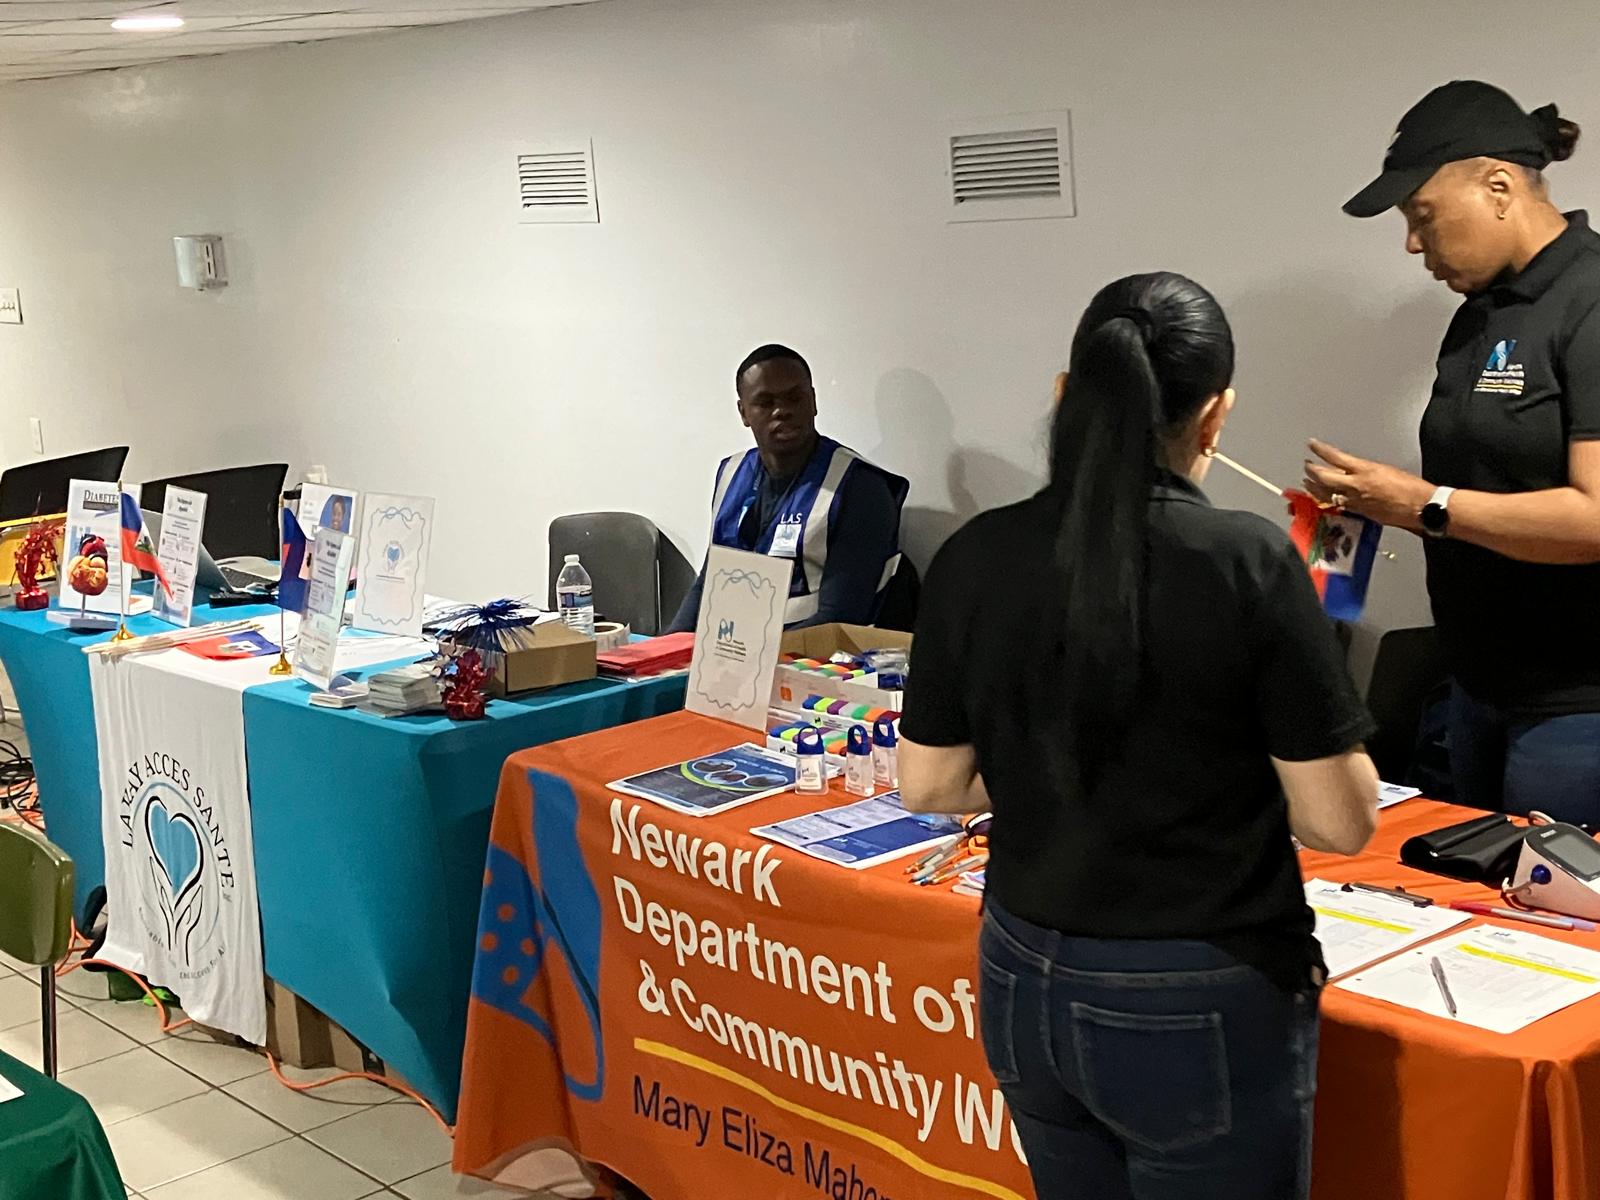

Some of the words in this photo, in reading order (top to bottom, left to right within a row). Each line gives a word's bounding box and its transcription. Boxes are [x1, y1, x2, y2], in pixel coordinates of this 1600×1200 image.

[780, 513, 802, 524] LAS
[144, 752, 190, 791] ACCES
[193, 787, 235, 888] SANTE
[610, 798, 782, 907] Newark
[613, 876, 896, 1024] Department
[913, 978, 976, 1039] of
[638, 959, 671, 1016] &
[671, 978, 943, 1142] Community
[955, 1073, 1028, 1166] W
[633, 1075, 711, 1147] Mary
[722, 1106, 795, 1175] Eliza
[804, 1142, 891, 1200] Mah
